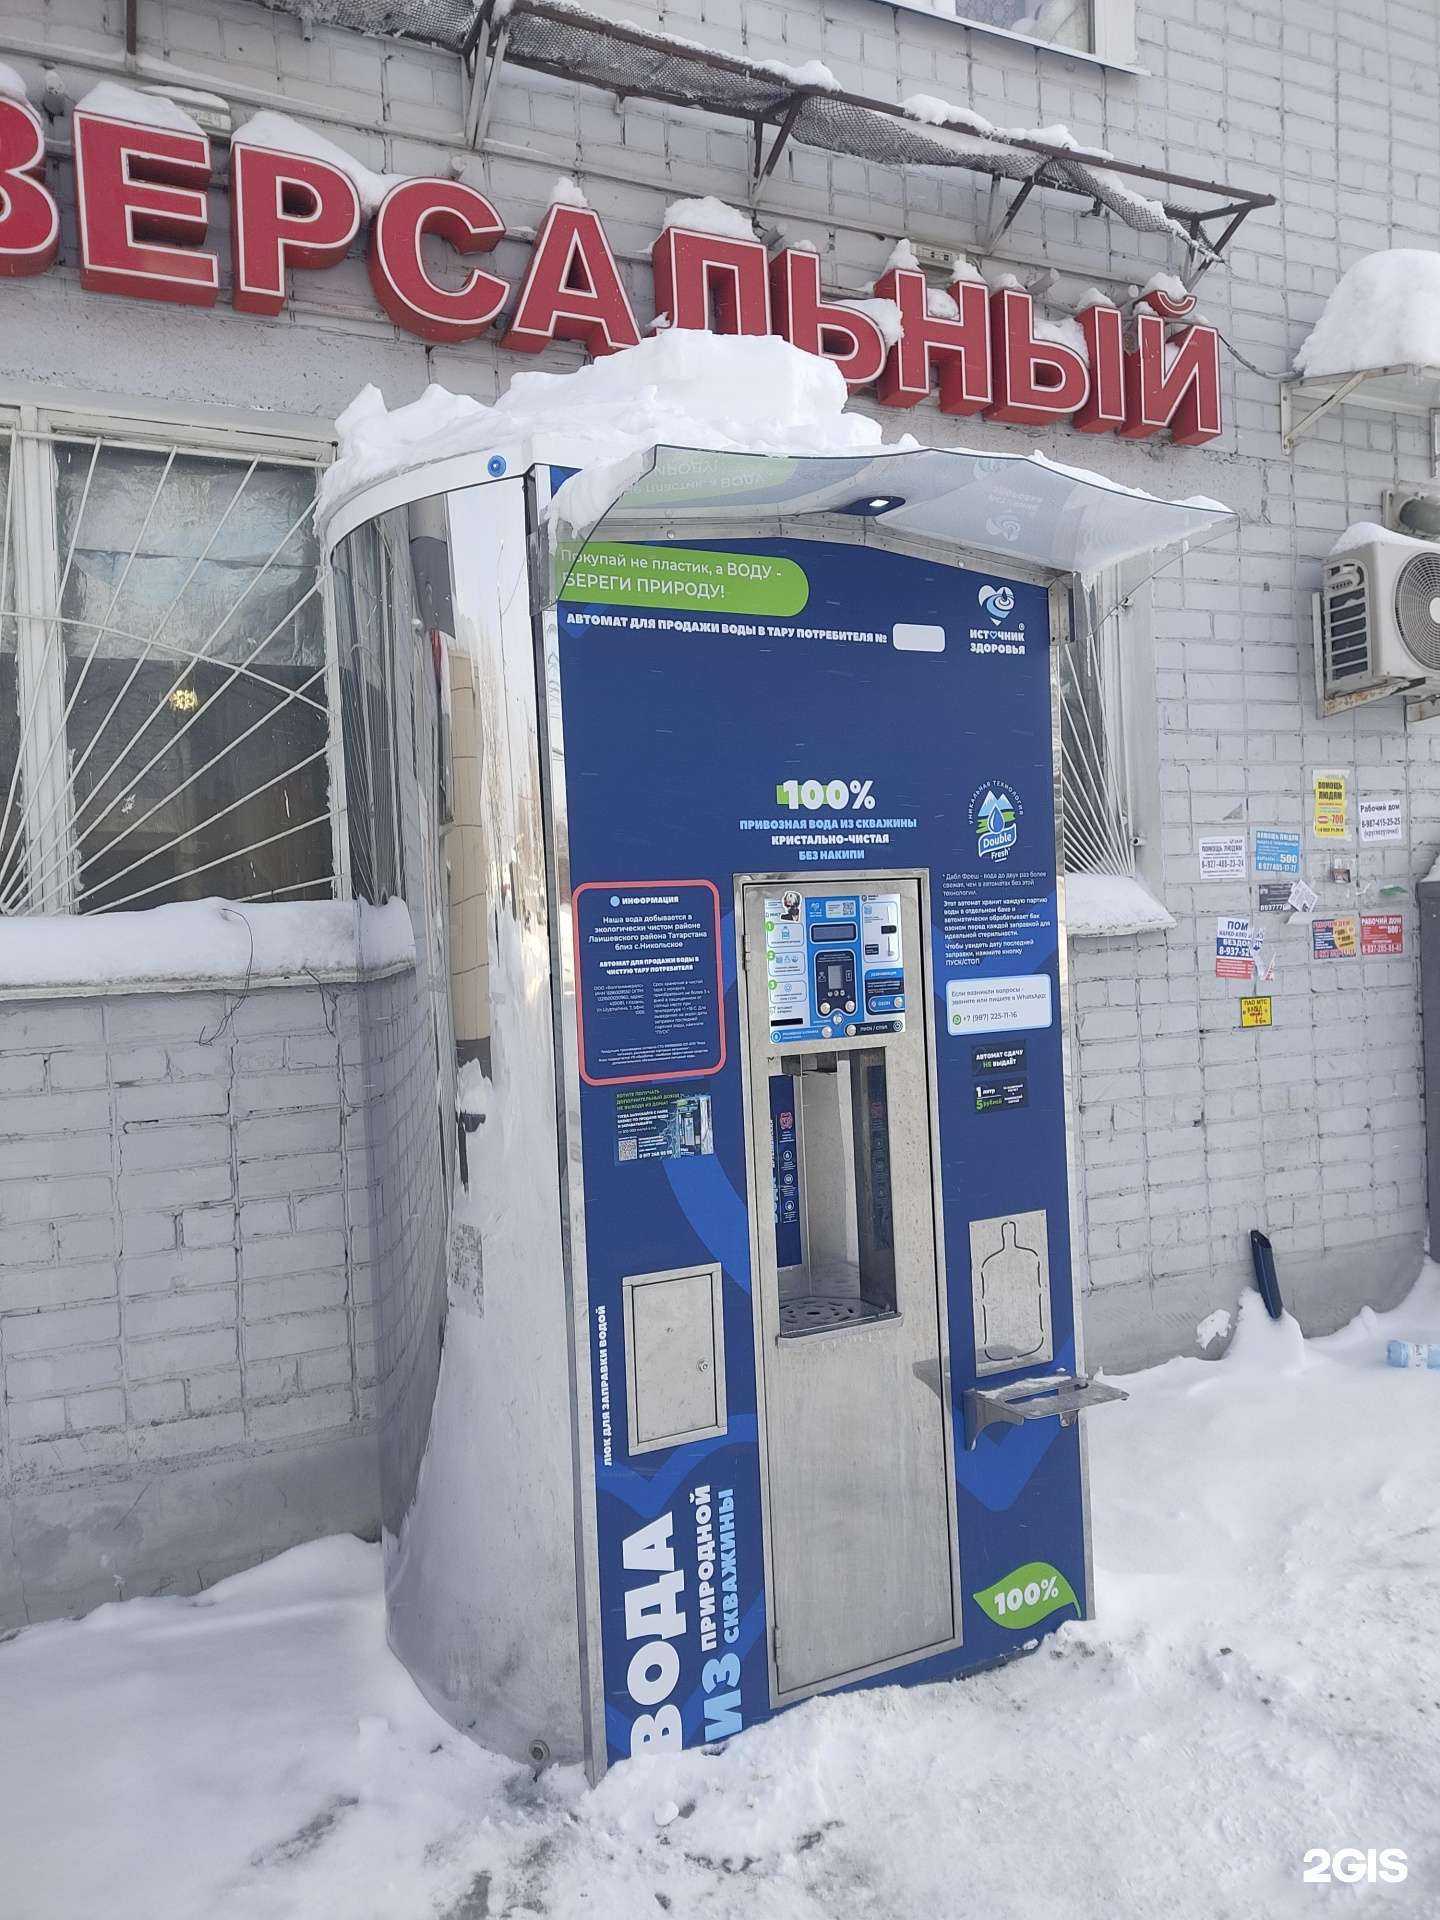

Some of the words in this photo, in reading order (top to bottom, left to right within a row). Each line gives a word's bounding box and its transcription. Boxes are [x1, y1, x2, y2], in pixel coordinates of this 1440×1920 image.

[561, 549, 626, 568] Покупай
[630, 558, 648, 569] не
[652, 559, 712, 575] пластик,
[715, 565, 723, 575] а
[727, 562, 772, 581] ВОДУ
[562, 573, 631, 592] БЕРЕГИ
[637, 578, 725, 600] ПРИРОДУ!
[566, 613, 628, 629] АВТОМАТ
[629, 617, 656, 630] ДЛЯ
[657, 618, 719, 634] ПРОДАЖИ
[721, 622, 756, 636] ВОДЫ
[757, 625, 766, 637] В
[767, 625, 795, 639] ТАРУ
[796, 627, 873, 643] ПОТРЕБИТЕЛЯ
[875, 633, 887, 643] №
[969, 642, 1026, 655] ЗДОРОВЬЯ
[783, 779, 876, 810] 100%
[993, 780, 1024, 815] ТЕХНОЛОГИЯ
[1360, 803, 1386, 812] Рабочий
[1388, 803, 1400, 811] дом
[739, 819, 807, 830] ПРИВОЗНАЯ
[808, 819, 838, 829] ВОДА
[840, 819, 855, 829] ИЗ
[855, 818, 917, 828] СКВАЖИНЫ
[771, 833, 890, 846] КРИСТАЛЬНО-ЧИСТАЯ
[983, 833, 1012, 849] Double
[799, 850, 819, 860] БЕЗ
[820, 850, 865, 860] НАКИПИ
[1280, 853, 1297, 864] 500
[621, 896, 679, 905] ИНФОРМАЦИЯ
[602, 916, 623, 924] Наша
[625, 916, 643, 924] вода
[644, 913, 687, 924] добывается
[594, 925, 646, 934] экологически
[647, 923, 673, 931] чистом
[674, 921, 701, 932] районе
[588, 934, 639, 944] Лаишевского
[639, 932, 667, 942] района
[668, 931, 707, 940] Татарстана
[614, 942, 633, 951] близ
[599, 959, 630, 968] АВТОМАТ
[629, 958, 643, 967] ДЛЯ
[644, 957, 675, 966] ПРОДАЖИ
[676, 956, 693, 965] ВОДЫ
[606, 967, 634, 975] ЧИСТУЮ
[634, 966, 649, 974] ТАРУ
[649, 964, 693, 973] ПОТРЕБИТЕЛЯ
[976, 1052, 1003, 1061] АВТОМАТ
[1003, 1049, 1024, 1058] СДАЧУ
[976, 1086, 982, 1098] 1
[976, 1099, 983, 1110] 5
[596, 1305, 607, 1348] ВОДОЙ
[600, 1349, 610, 1411] ЗАПРАВКИ
[602, 1412, 611, 1437] ДЛЯ
[603, 1437, 612, 1466] ЛЮК
[689, 1485, 717, 1652] ПРИРОДНОЙ
[718, 1489, 740, 1644] СКВАЖИНЫ
[994, 1575, 1060, 1616] 100%
[622, 1511, 687, 1757] ВОДА
[702, 1653, 743, 1742] ИЗ
